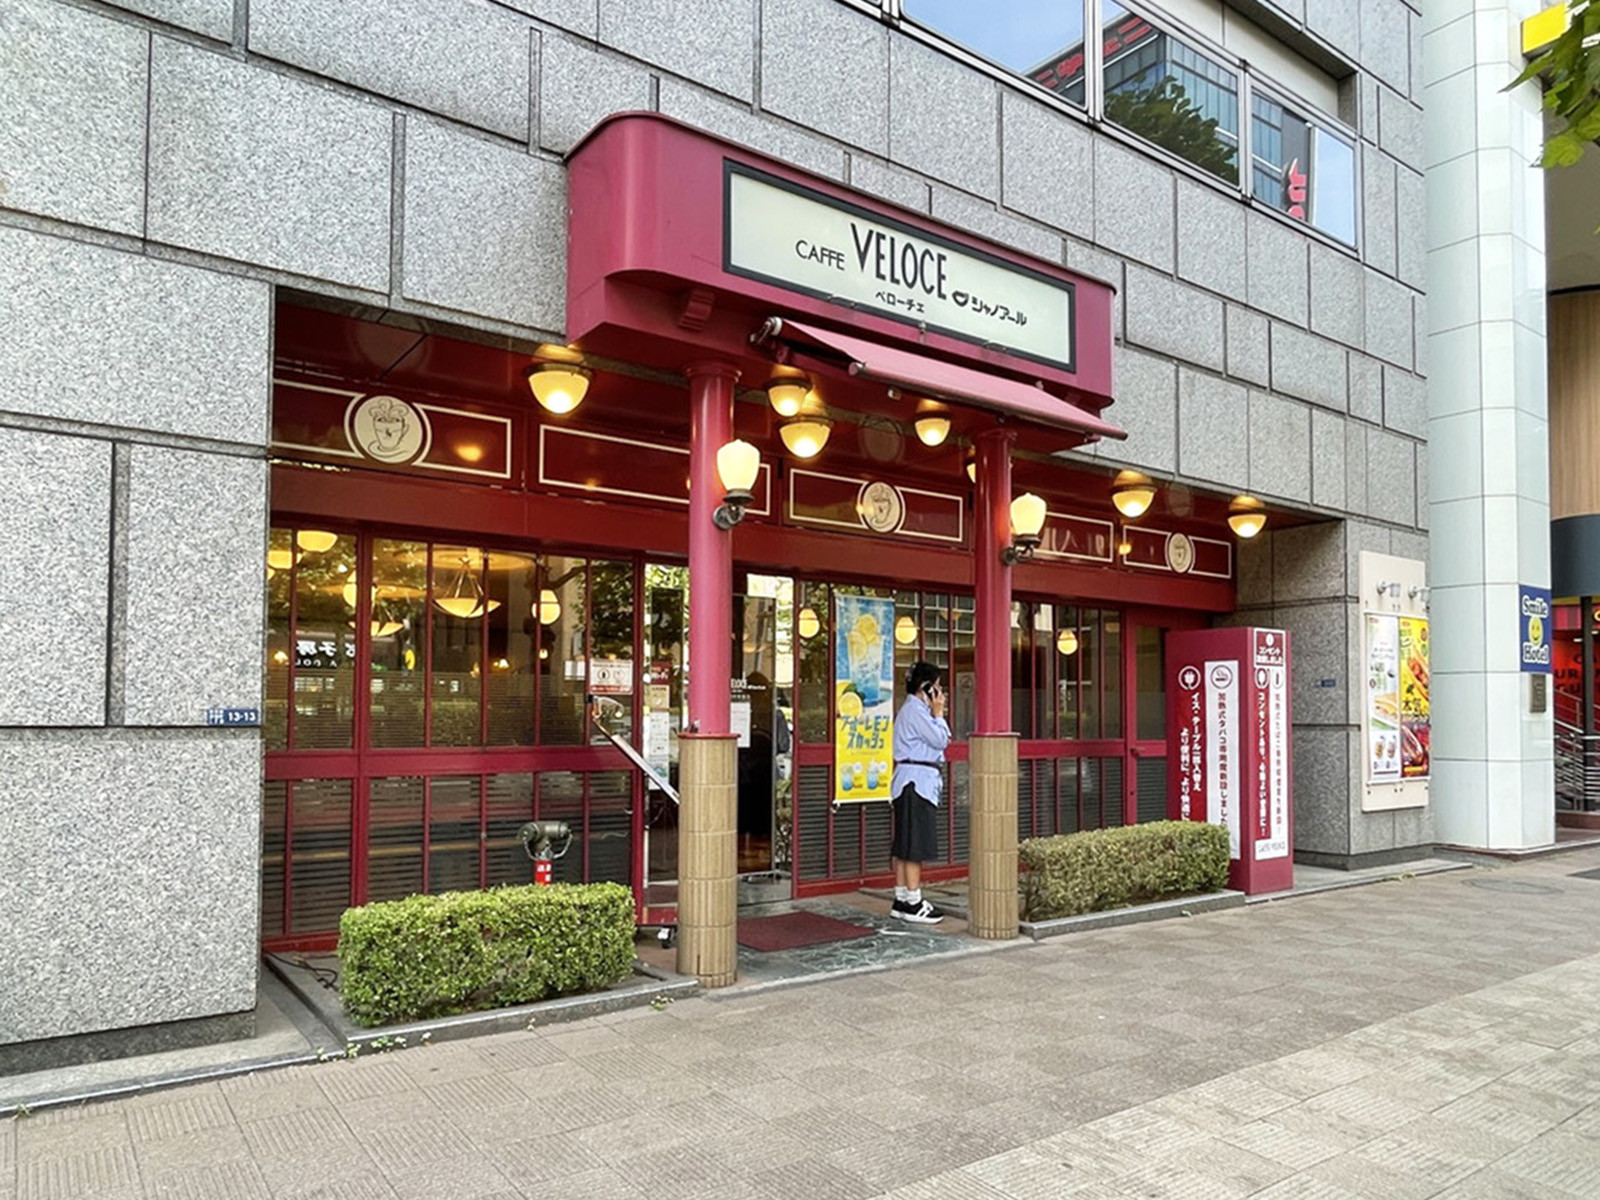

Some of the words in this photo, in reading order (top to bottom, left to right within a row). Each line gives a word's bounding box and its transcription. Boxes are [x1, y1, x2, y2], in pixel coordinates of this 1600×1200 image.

[795, 240, 845, 271] CAFFE
[851, 222, 948, 300] VELOCE
[875, 290, 925, 314] ベローチェ
[971, 298, 1027, 327] シャノアール
[1523, 596, 1548, 617] Smile
[1523, 642, 1549, 664] Hotel
[228, 711, 256, 722] 13-13
